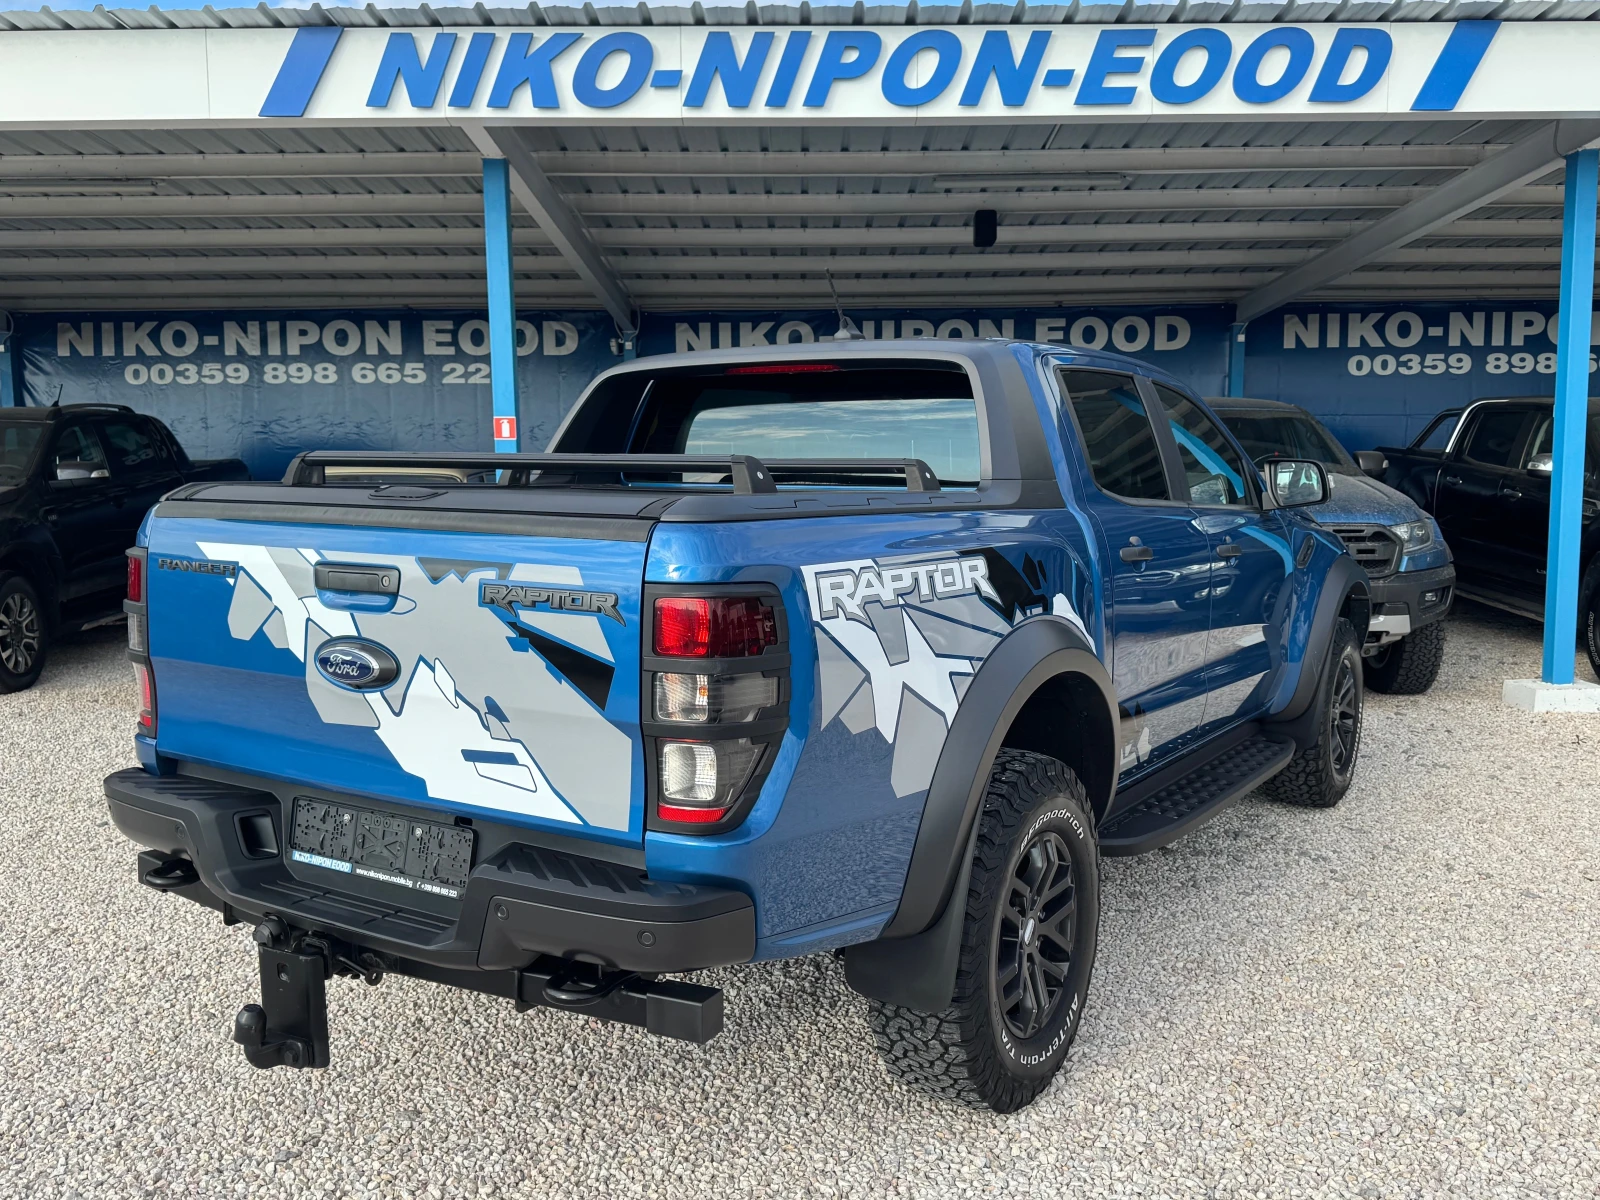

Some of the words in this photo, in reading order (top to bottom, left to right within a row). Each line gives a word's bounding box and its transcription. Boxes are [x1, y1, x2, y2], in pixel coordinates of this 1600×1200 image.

[366, 26, 1393, 109] NIKO-NIPON-EOOD
[56, 320, 402, 357] NIKO-NIPON
[422, 319, 579, 357] EOOD
[1035, 315, 1191, 352] EOOD
[1283, 311, 1600, 349] NIKO-NIP
[124, 363, 249, 385] 00359
[263, 362, 338, 384] 898
[351, 362, 427, 384] 665
[441, 362, 491, 384] 22
[1347, 353, 1472, 376] 00359
[1485, 352, 1557, 374] 898
[158, 558, 236, 577] RANGER
[482, 583, 626, 627] RAPTOR
[817, 556, 1005, 624] RAPTOR
[327, 653, 360, 676] Ford
